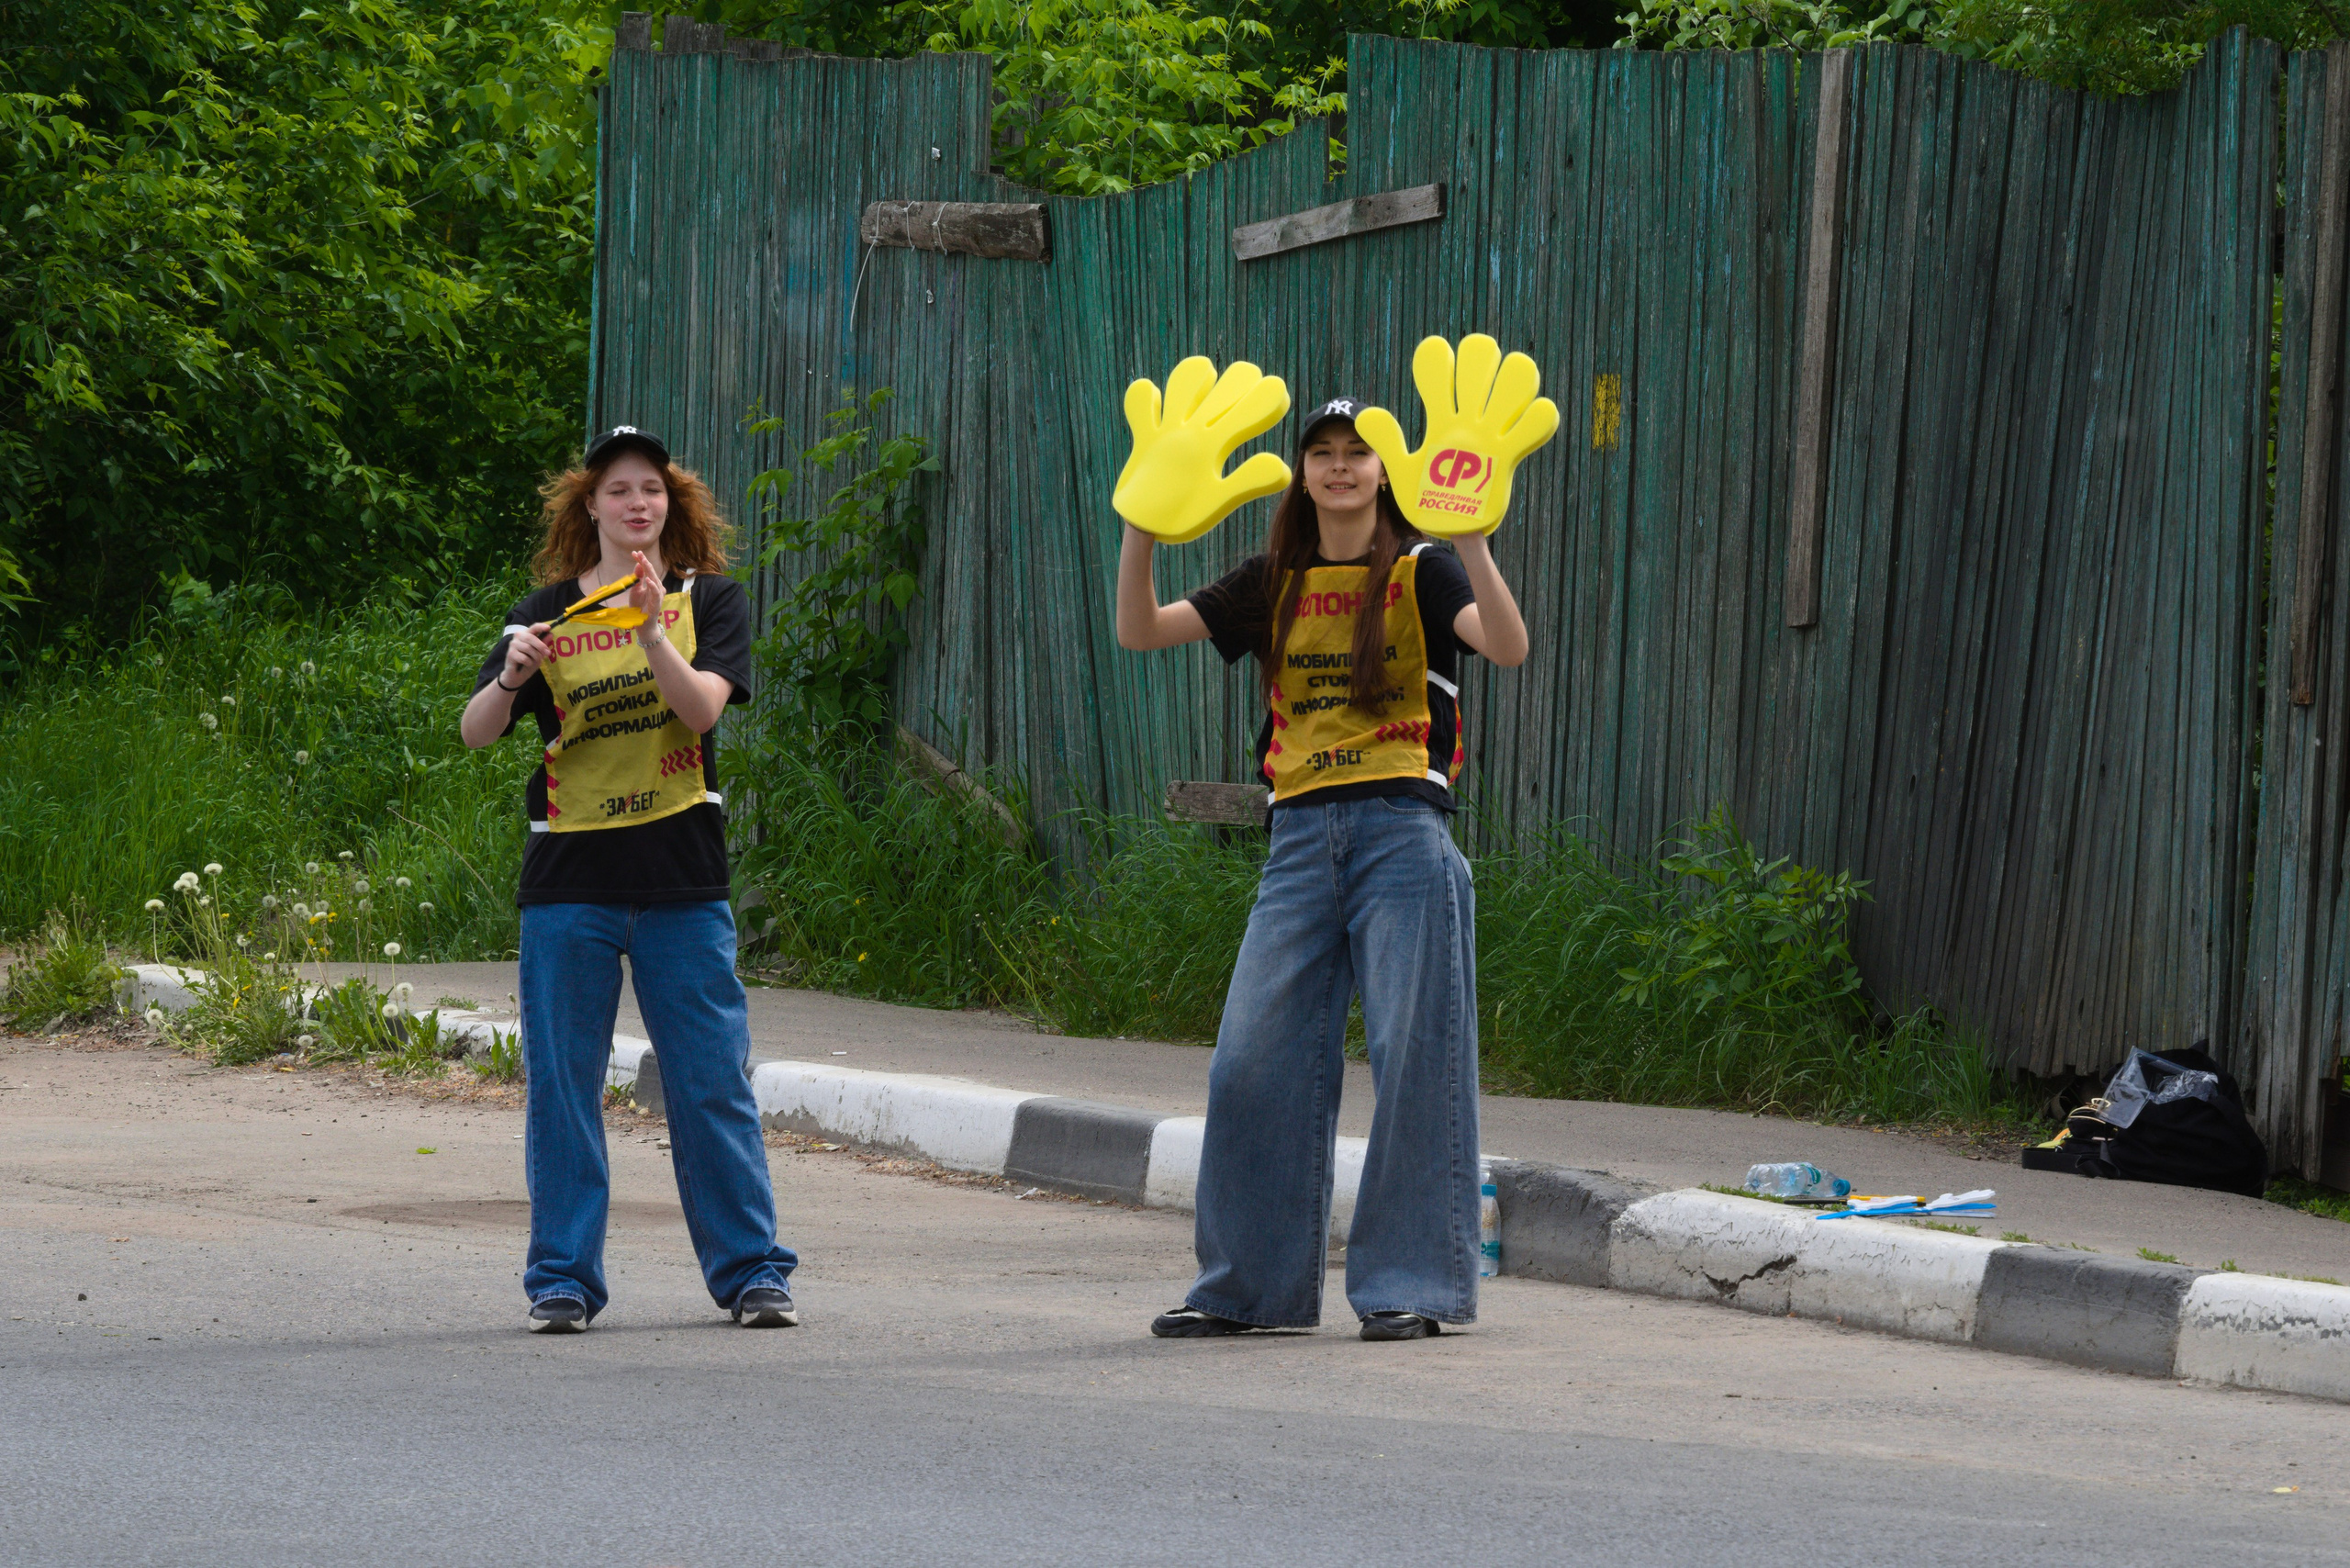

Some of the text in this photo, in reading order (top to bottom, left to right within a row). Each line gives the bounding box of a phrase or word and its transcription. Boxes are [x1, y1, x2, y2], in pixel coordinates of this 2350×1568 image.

[1422, 489, 1483, 506] СПРАВЕДЛИВАЯ
[1418, 498, 1478, 516] РОССИЯ
[566, 666, 655, 707] МОБИЛЬН
[1307, 673, 1351, 688] СТОЙ
[584, 690, 658, 722] СТОЙКА
